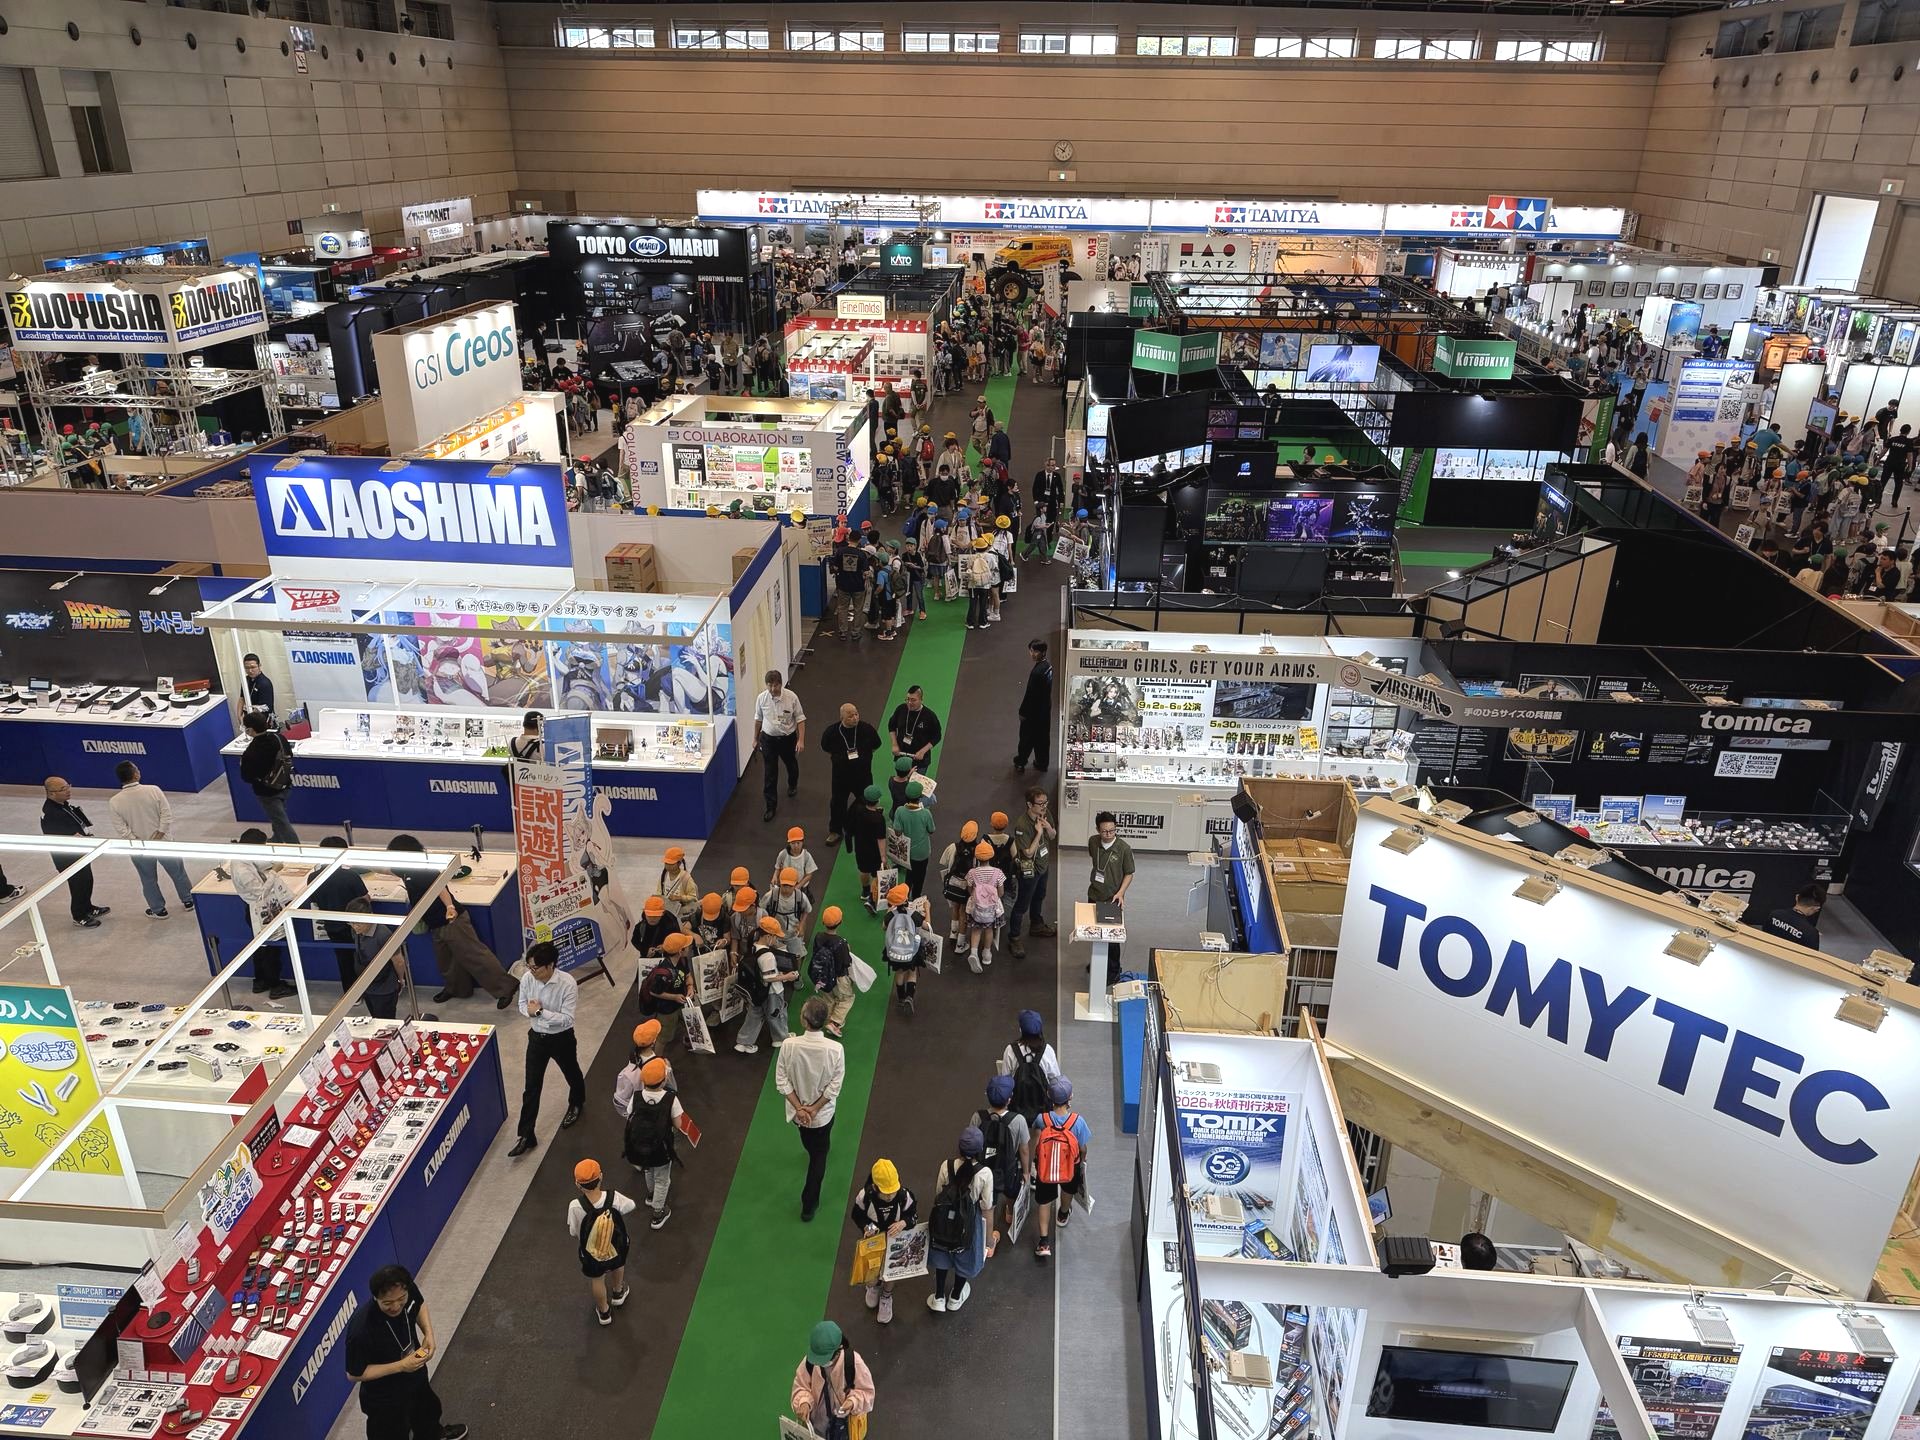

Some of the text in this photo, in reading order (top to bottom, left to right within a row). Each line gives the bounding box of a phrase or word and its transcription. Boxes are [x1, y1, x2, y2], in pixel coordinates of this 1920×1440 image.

[424, 207, 450, 221] HORNET
[1017, 205, 1088, 219] TAMIYA
[1248, 209, 1320, 223] TAMIYA
[576, 235, 626, 255] TOKYO
[669, 238, 719, 257] MARUI
[1087, 237, 1097, 260] EVO.
[890, 254, 912, 264] KATO
[1179, 260, 1235, 269] PLATZ
[698, 275, 724, 283] SHOOTING
[185, 277, 262, 328] DOYUSHA
[30, 292, 166, 330] DOYUSHA
[20, 331, 51, 342] Leading
[51, 332, 64, 340] the
[65, 332, 86, 341] world
[88, 333, 95, 341] in
[97, 333, 120, 341] model
[179, 327, 200, 341] Leading
[206, 324, 220, 335] world
[225, 319, 239, 330] model
[415, 325, 514, 389] GSI Creos
[1136, 342, 1176, 362] KOTOBUKIYA
[1181, 347, 1215, 362] KOTOBUKIYA
[1456, 352, 1509, 368] KOTOBUKIYA
[683, 430, 788, 445] COLLABORATION
[675, 452, 702, 460] EVANGELION
[680, 458, 698, 466] COLOR
[625, 425, 641, 508] COLLABORATION
[835, 433, 848, 515] NEW COLORS
[330, 478, 557, 547] AOSHIMA
[291, 590, 336, 600] マクロス
[64, 600, 125, 618] BACK
[295, 598, 337, 608] モデラーズ
[82, 617, 131, 629] FUTURE
[307, 652, 355, 665] AOSHIMA
[1133, 658, 1321, 678] GIRLS, GET YOUR ARMS.
[1183, 702, 1202, 711] 公演
[1699, 709, 1812, 734] tomica
[1211, 732, 1296, 746] 一般販売開始
[1592, 742, 1605, 751] 64
[97, 740, 147, 755] AOSHIMA
[444, 780, 498, 795] AOSHIMA
[604, 786, 658, 801] AOSHIMA
[1650, 864, 1756, 889] mica
[1771, 917, 1802, 939] TOMYTEC
[1369, 883, 1891, 1165] TOMYTEC
[1178, 1089, 1207, 1097] トミックス
[1181, 1112, 1281, 1133] TOMIX
[433, 1103, 471, 1166] AOSHIMA
[1190, 1127, 1268, 1138] TOMIX 50th ANNIVERSARY
[1193, 1132, 1264, 1142] COMMEMORATIVE BOOK
[72, 1287, 103, 1296] SNAP CAR
[307, 1289, 358, 1383] AOSHIMA
[1799, 1350, 1866, 1365] 会場発表
